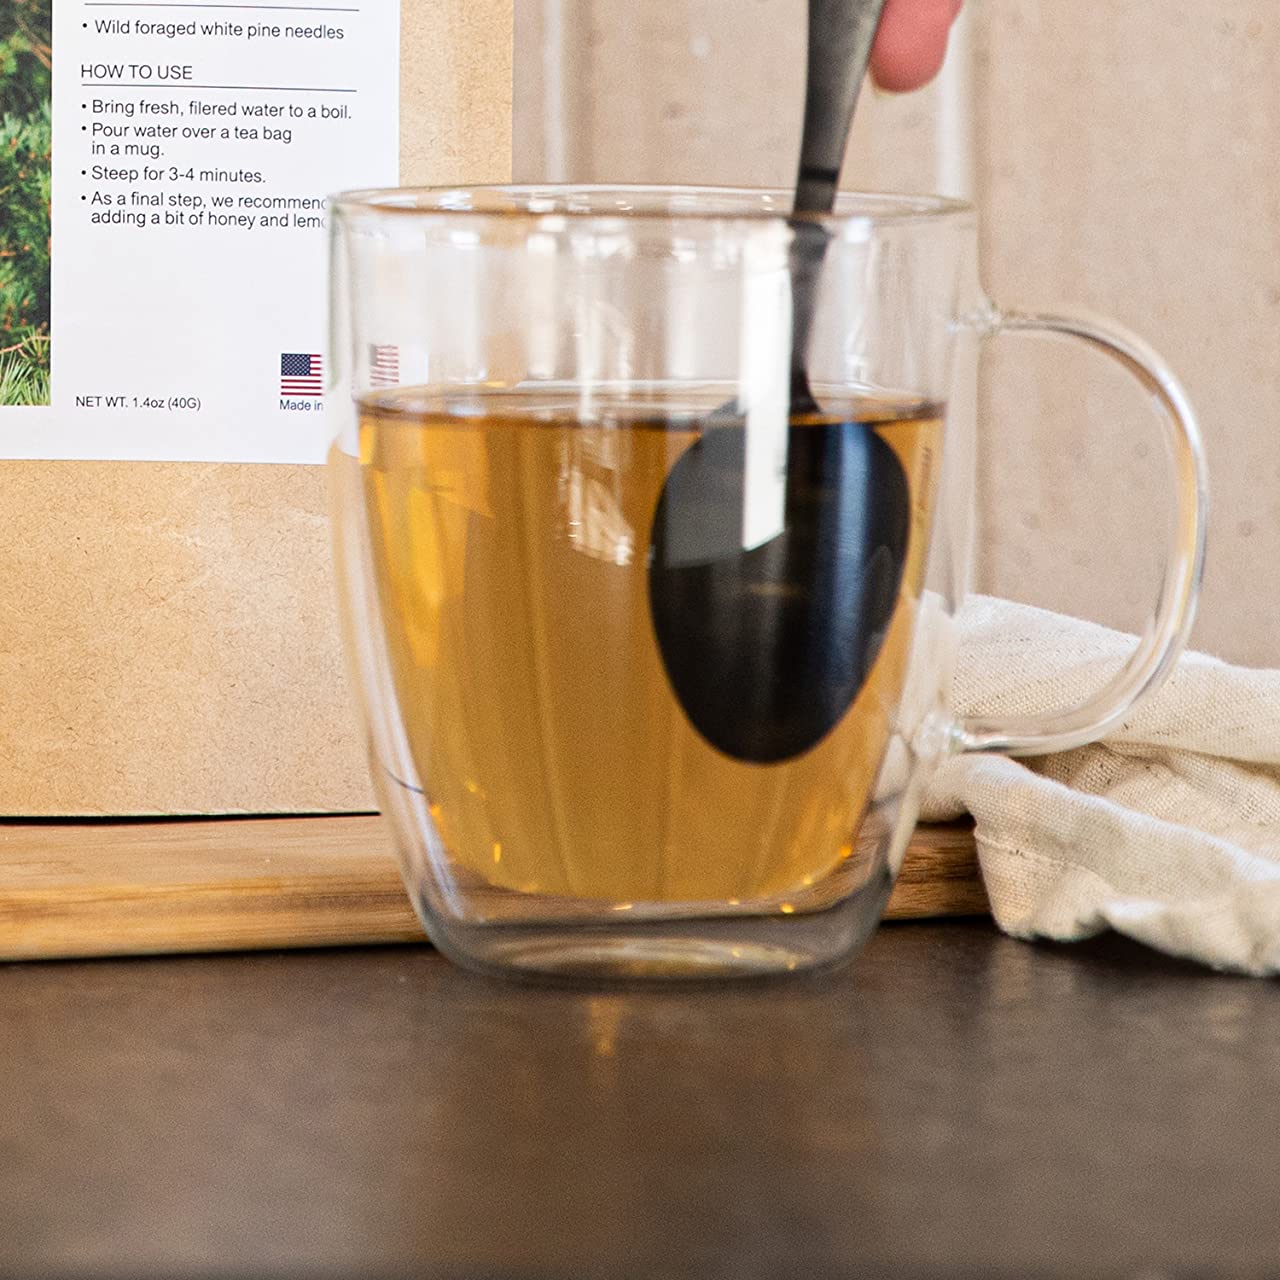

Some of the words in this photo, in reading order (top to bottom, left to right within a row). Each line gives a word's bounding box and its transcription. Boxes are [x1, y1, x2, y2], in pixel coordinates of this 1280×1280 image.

[94, 19, 131, 35] Wild
[134, 19, 196, 39] foraged
[200, 21, 244, 37] white
[247, 22, 281, 40] pine
[285, 24, 345, 40] needles
[80, 63, 125, 80] HOW
[127, 64, 153, 80] TO
[157, 64, 193, 81] USE
[92, 99, 135, 118] Bring
[138, 99, 184, 117] fresh,
[188, 100, 237, 116] filered
[241, 103, 285, 118] water
[288, 103, 304, 118] to
[307, 106, 317, 119] a
[321, 104, 352, 120] boil.
[92, 122, 130, 138] Pour
[133, 124, 179, 138] water
[181, 126, 217, 139] over
[220, 127, 230, 140] a
[233, 125, 259, 140] tea
[262, 125, 292, 145] bag
[91, 140, 106, 155] in
[109, 143, 120, 156] a
[124, 144, 165, 160] mug.
[91, 164, 139, 184] Steep
[143, 165, 165, 181] for
[168, 166, 195, 182] 3-4
[199, 167, 266, 184] minutes.
[90, 190, 113, 206] As
[116, 194, 127, 206] a
[130, 190, 164, 207] final
[168, 192, 207, 211] step,
[210, 196, 234, 208] we
[90, 209, 146, 229] adding
[150, 213, 161, 225] a
[164, 209, 185, 226] bit
[188, 210, 205, 226] of
[208, 210, 257, 231] honey
[259, 212, 289, 228] and
[75, 395, 102, 408] NET
[104, 396, 129, 408] WT.
[132, 396, 165, 409] 1.4oz
[167, 396, 202, 412] (40G)
[279, 398, 312, 412] Made
